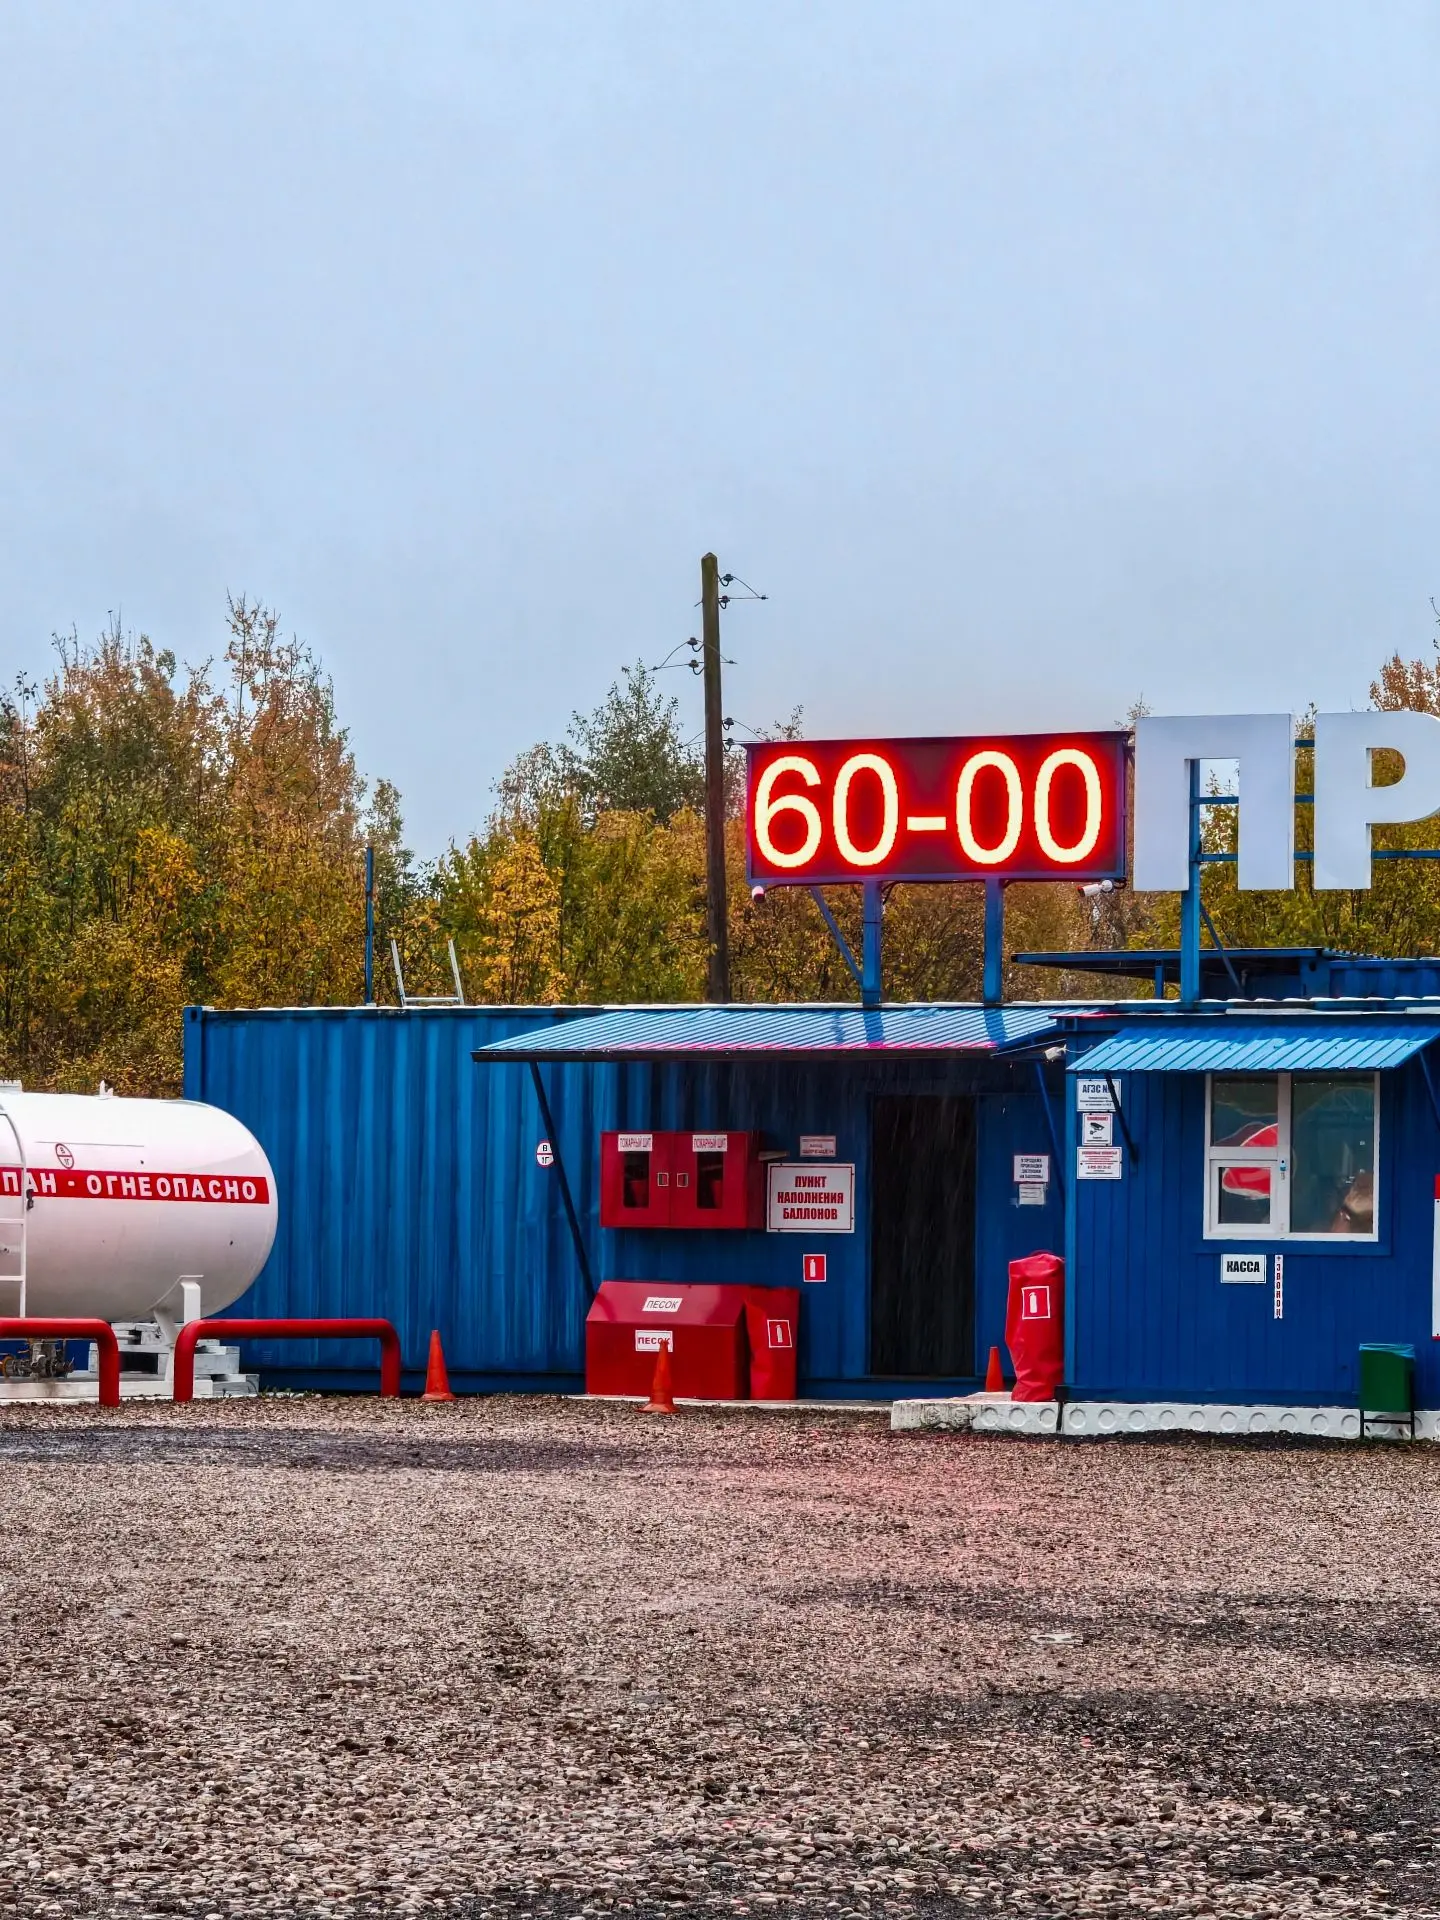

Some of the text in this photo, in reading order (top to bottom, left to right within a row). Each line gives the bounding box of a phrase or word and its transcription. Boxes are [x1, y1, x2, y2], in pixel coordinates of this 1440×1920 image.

[754, 748, 1103, 868] 60-00
[542, 1144, 548, 1152] В
[86, 1174, 257, 1201] ОГНЕОПАСНО
[794, 1175, 827, 1188] ПУНКТ
[777, 1191, 844, 1204] НАПОЛНЕНИЯ
[783, 1207, 838, 1220] БАЛЛОНОВ
[1226, 1260, 1260, 1273] КАССА
[646, 1300, 679, 1309] ПЕСОК
